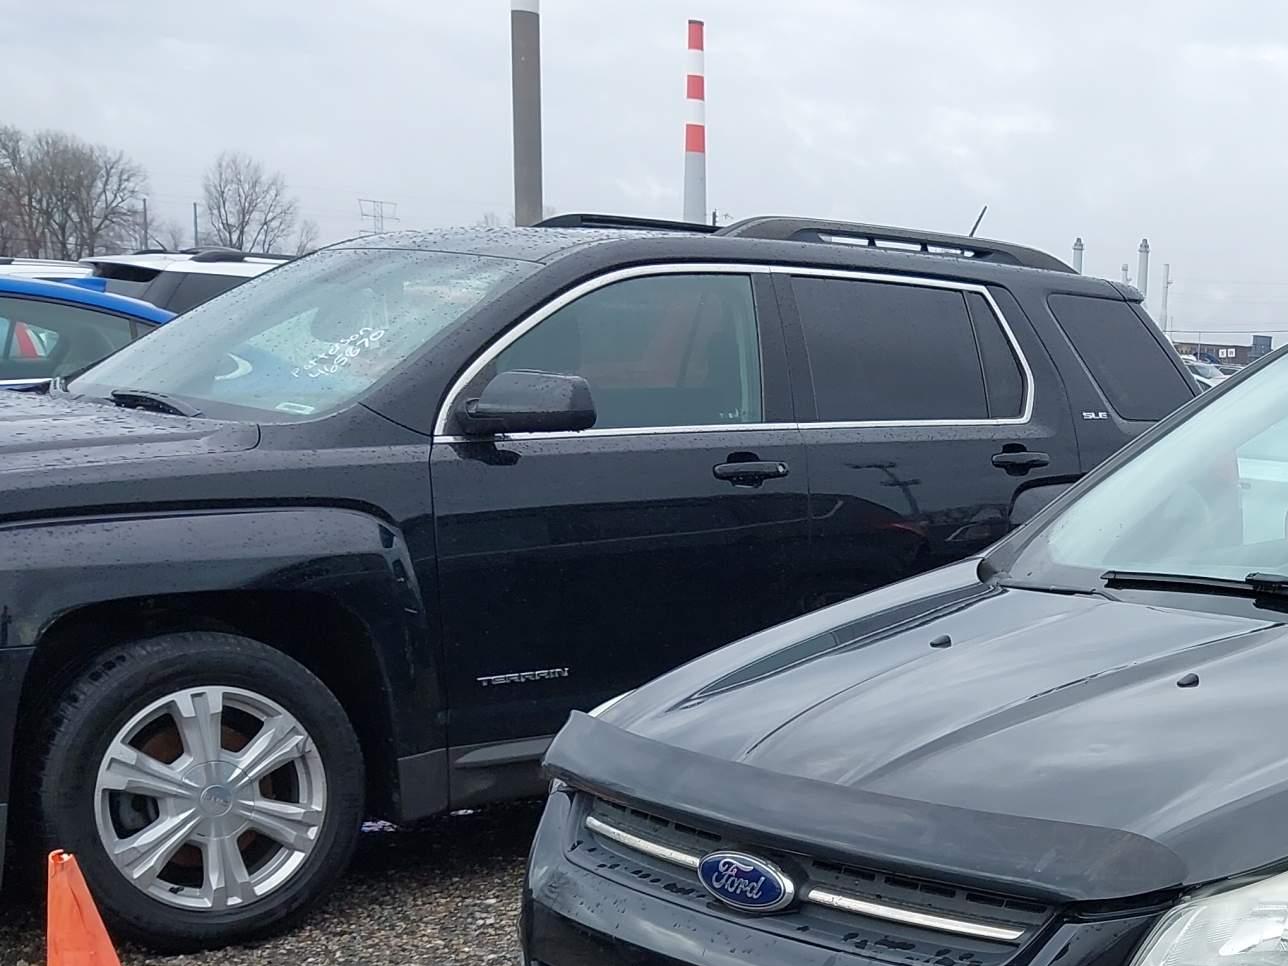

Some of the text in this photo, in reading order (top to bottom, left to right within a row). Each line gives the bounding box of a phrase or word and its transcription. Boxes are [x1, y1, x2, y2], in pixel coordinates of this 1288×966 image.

[1082, 411, 1108, 420] SLE
[476, 667, 570, 687] TERRAIN
[711, 858, 766, 899] Ford
